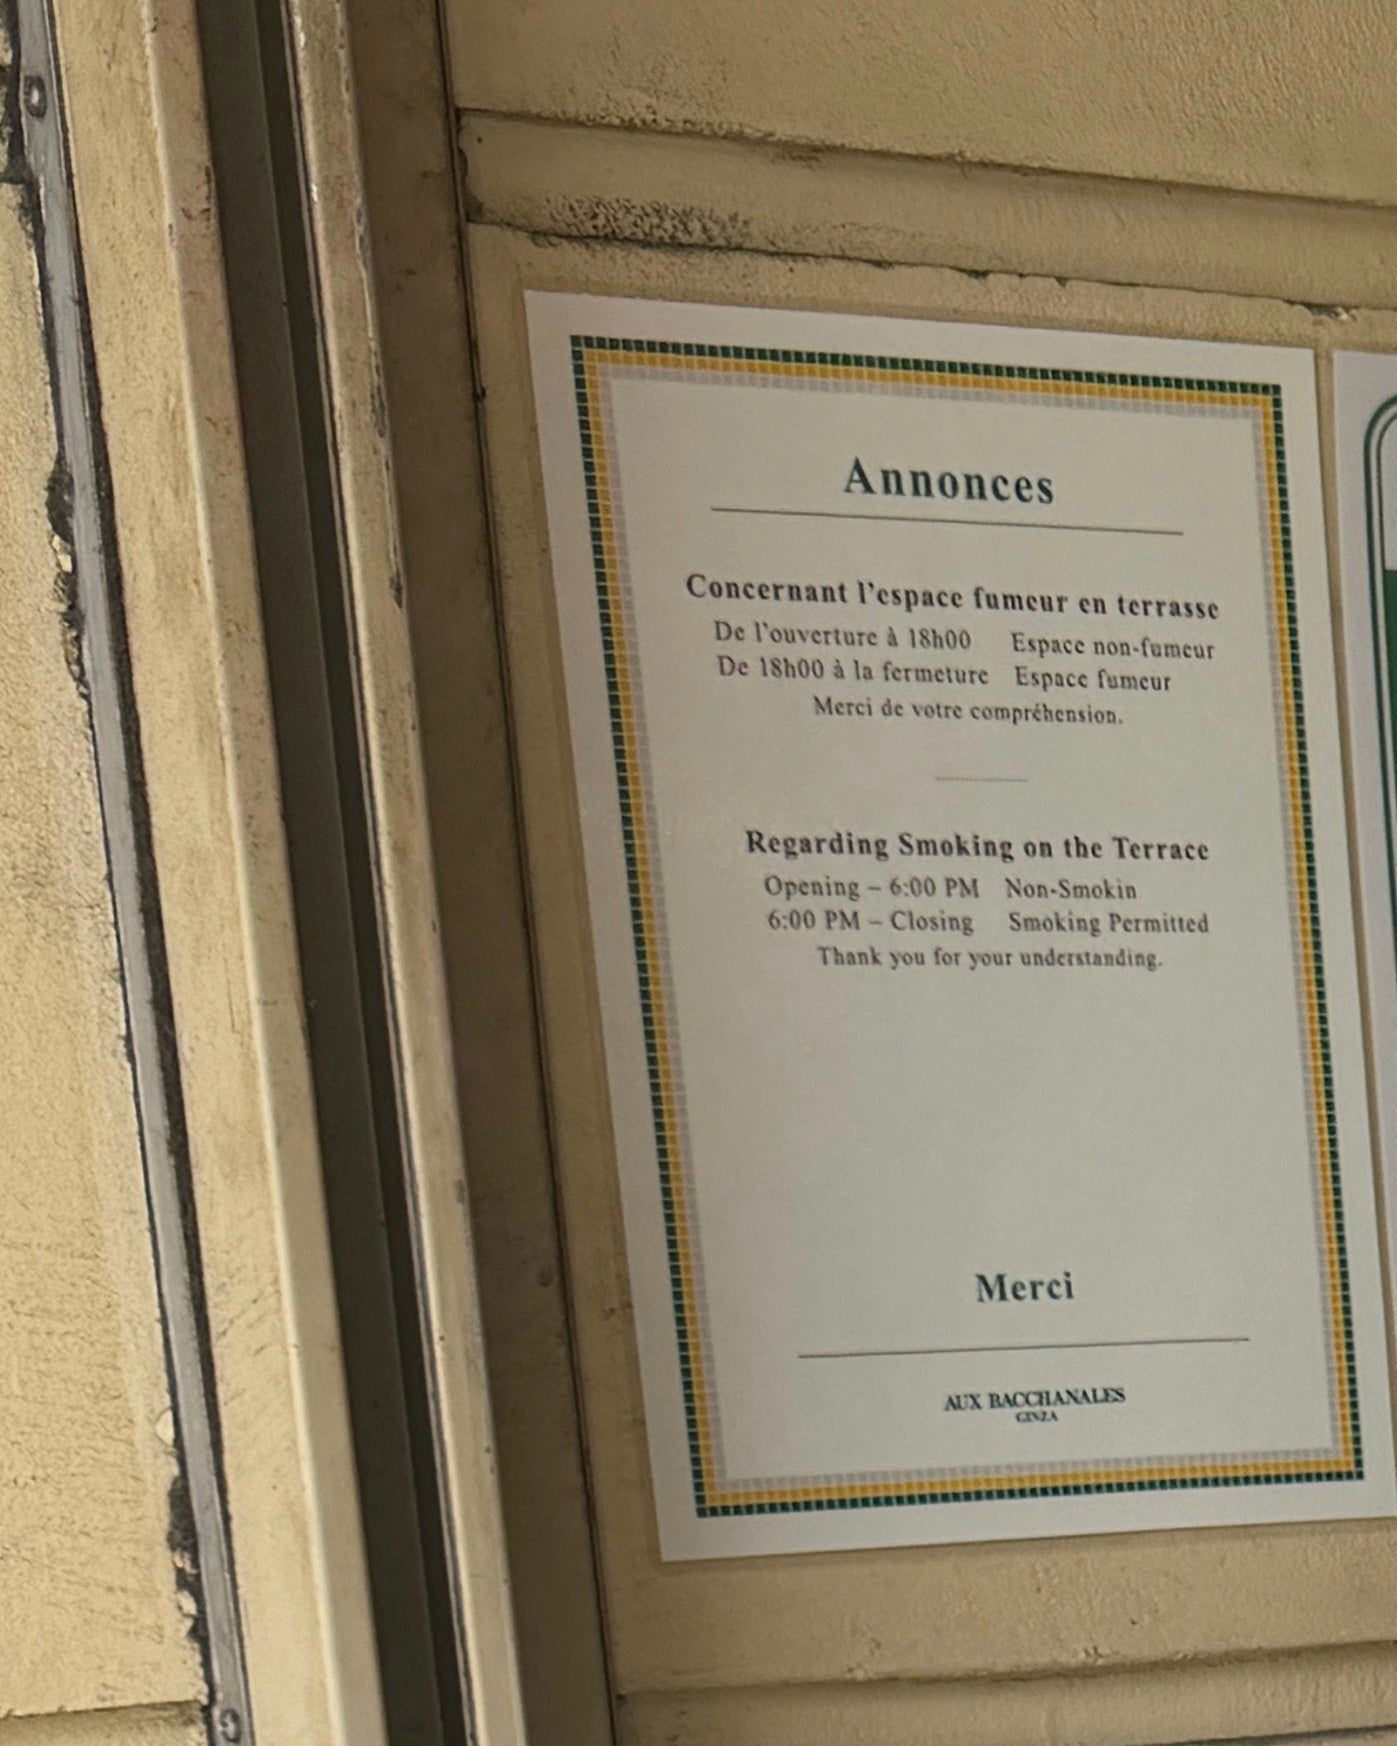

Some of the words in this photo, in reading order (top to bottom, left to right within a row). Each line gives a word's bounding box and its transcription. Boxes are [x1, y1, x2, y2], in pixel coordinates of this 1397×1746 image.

[842, 455, 1054, 505] Annonces
[685, 572, 847, 605] Concernant
[972, 586, 1069, 615] fumeur
[1078, 594, 1107, 616] en
[1117, 597, 1220, 622] terrasse
[713, 619, 745, 643] De
[886, 626, 899, 649] à
[908, 627, 973, 651] 18h00
[1011, 632, 1086, 659] Espace
[1092, 636, 1217, 661] non-fumeur
[717, 654, 749, 678] De
[760, 656, 825, 681] 18h00
[832, 660, 846, 681] à
[853, 660, 875, 682] la
[882, 661, 990, 686] fermeture
[1015, 665, 1089, 693] Espace
[1096, 668, 1172, 692] fumeur
[813, 696, 873, 718] Merci
[881, 698, 904, 719] de
[911, 700, 964, 721] votre
[970, 702, 1125, 727] compréhension.
[746, 829, 890, 863] Regarding
[897, 832, 1015, 865] Smoking
[1022, 840, 1054, 860] on
[1063, 835, 1104, 860] the
[1112, 836, 1210, 861] Terrace
[764, 874, 861, 903] Opening
[889, 876, 937, 899] 6:00
[944, 877, 980, 899] PM
[1004, 876, 1138, 901] Non-Smokin
[767, 909, 817, 931] 6:00
[825, 909, 861, 932] PM
[890, 909, 975, 937] Closing
[1008, 909, 1103, 938] Smoking
[1107, 912, 1211, 934] Permitted
[817, 946, 883, 967] Thank
[889, 952, 926, 971] you
[933, 947, 962, 967] for
[968, 952, 1013, 972] your
[1019, 948, 1164, 973] understanding.
[975, 1270, 1075, 1304] Merci
[943, 1393, 984, 1412] AUX
[987, 1386, 1127, 1410] BACCHANALES
[1015, 1410, 1059, 1423] GINZA
